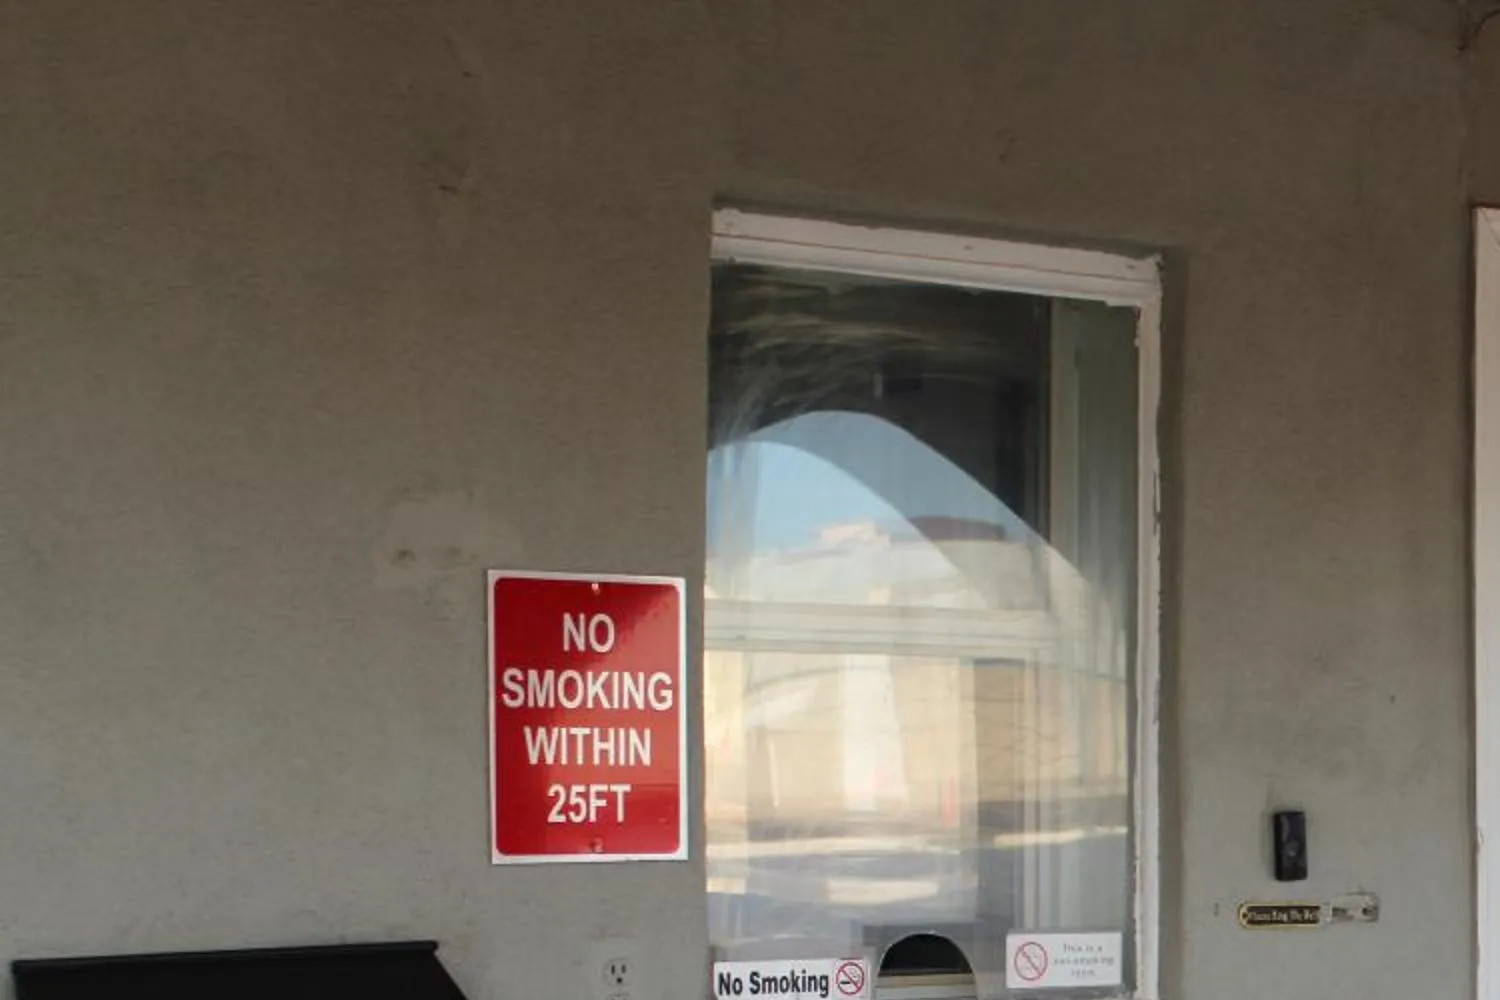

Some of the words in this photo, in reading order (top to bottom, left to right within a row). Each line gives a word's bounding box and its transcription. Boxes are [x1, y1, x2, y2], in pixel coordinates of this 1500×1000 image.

[562, 613, 615, 652] NO
[503, 668, 673, 710] SMOKING
[524, 726, 652, 766] WITHIN
[548, 784, 631, 823] 25FT
[718, 972, 743, 996] No
[749, 968, 829, 998] Smoking
